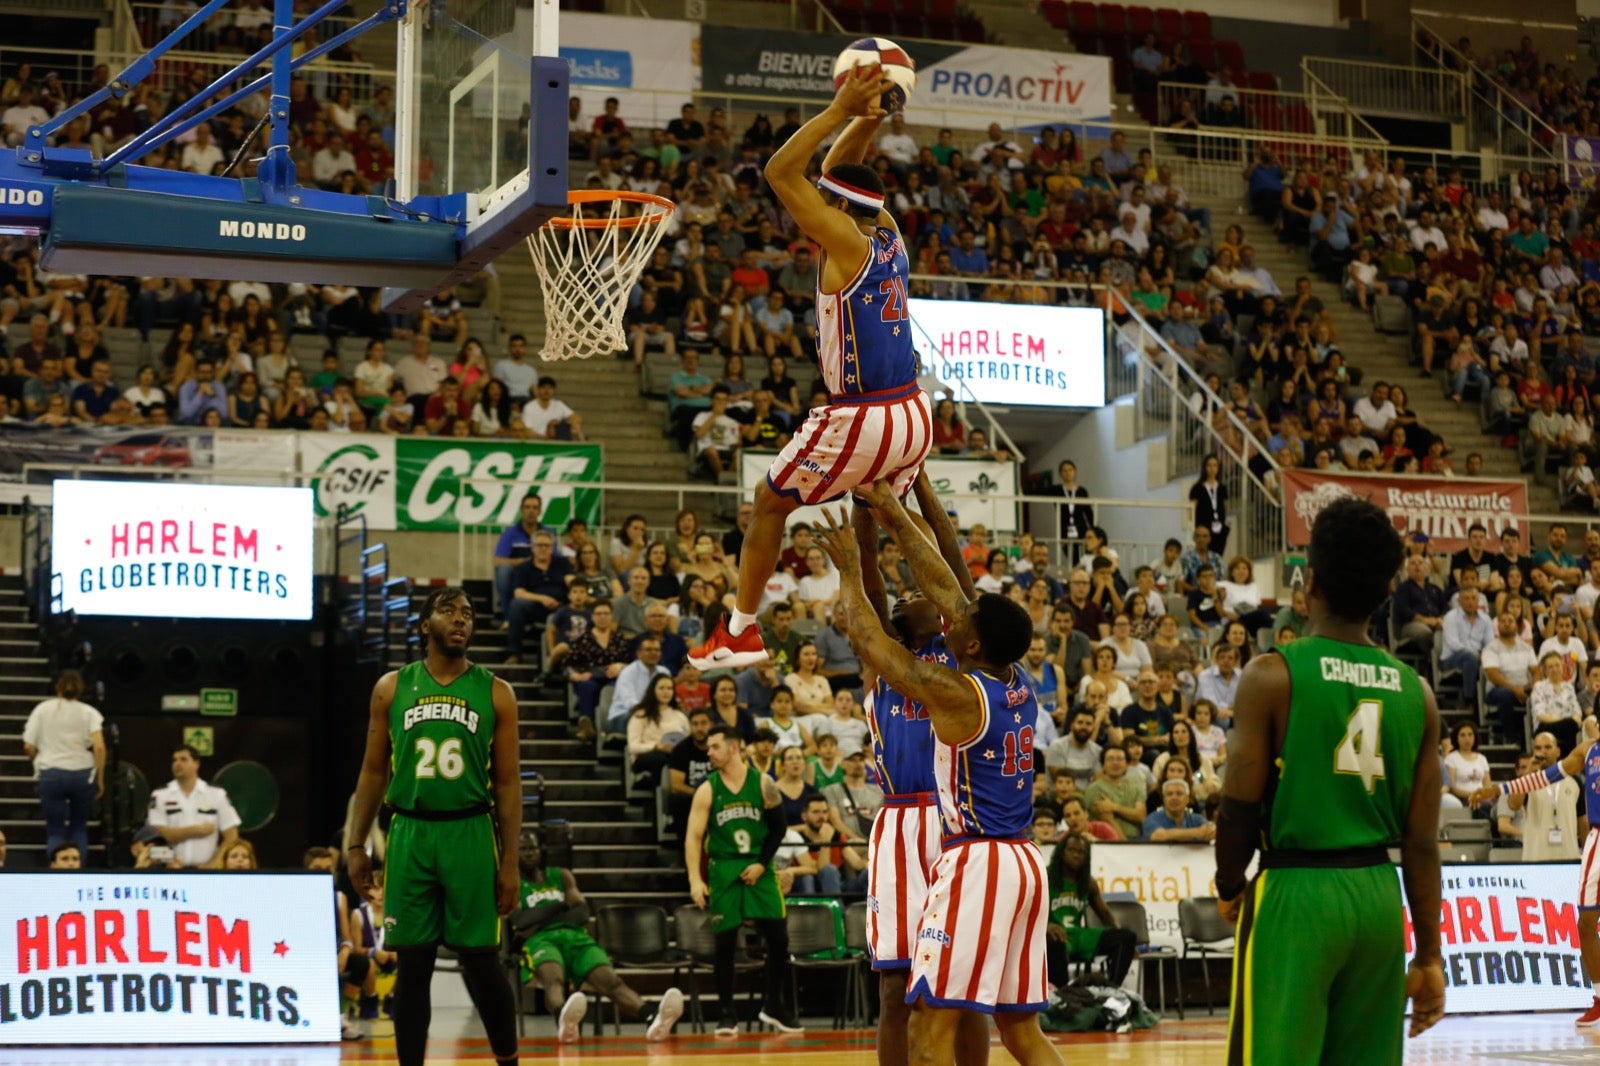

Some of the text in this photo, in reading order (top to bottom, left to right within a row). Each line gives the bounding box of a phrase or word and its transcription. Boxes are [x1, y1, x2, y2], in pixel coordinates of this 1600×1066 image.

[930, 68, 1085, 105] PROACTIV
[219, 220, 306, 241] MONDO
[880, 275, 908, 322] 21
[940, 330, 1045, 362] HARLEM
[942, 360, 1067, 390] OBETROTTERS
[325, 467, 390, 494] CSIF
[407, 448, 590, 523] CSIF
[1387, 487, 1512, 511] Restaurante
[111, 519, 258, 563] HARLEM
[80, 562, 288, 599] GLOBETROTTERS
[1319, 655, 1403, 693] CHANDLER
[403, 702, 480, 735] GENERALS
[415, 736, 465, 780] 26
[1001, 724, 1034, 777] 19
[1333, 698, 1386, 795] 4
[733, 828, 752, 854] 9
[1468, 876, 1528, 891] ORIGINAL
[17, 909, 252, 975] HARLEM
